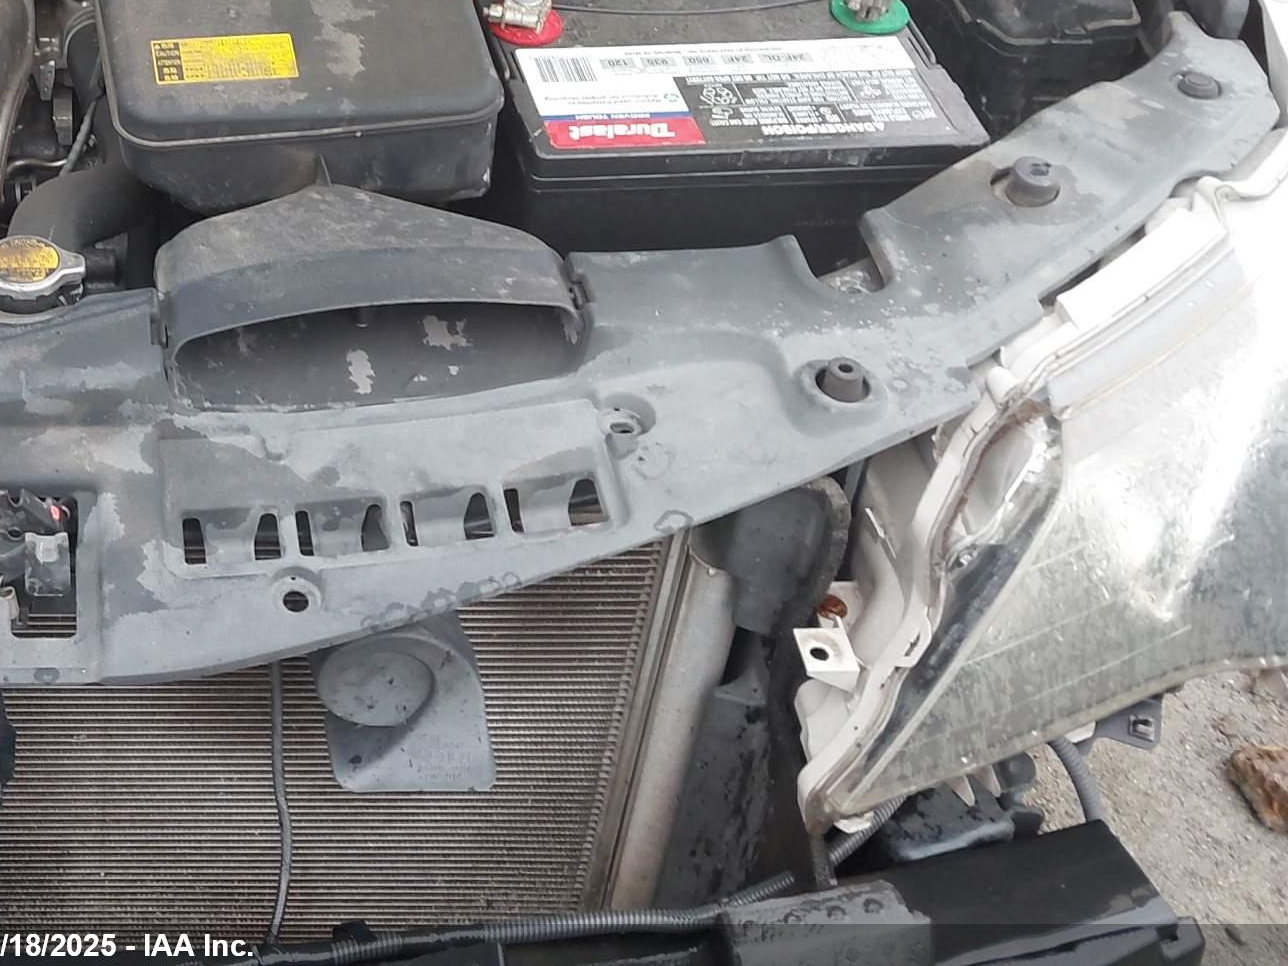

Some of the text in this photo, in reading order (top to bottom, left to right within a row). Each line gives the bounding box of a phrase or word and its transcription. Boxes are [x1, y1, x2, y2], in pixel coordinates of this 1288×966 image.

[155, 49, 180, 57] CAUTION
[607, 59, 628, 67] 120
[568, 122, 676, 140] Duralast
